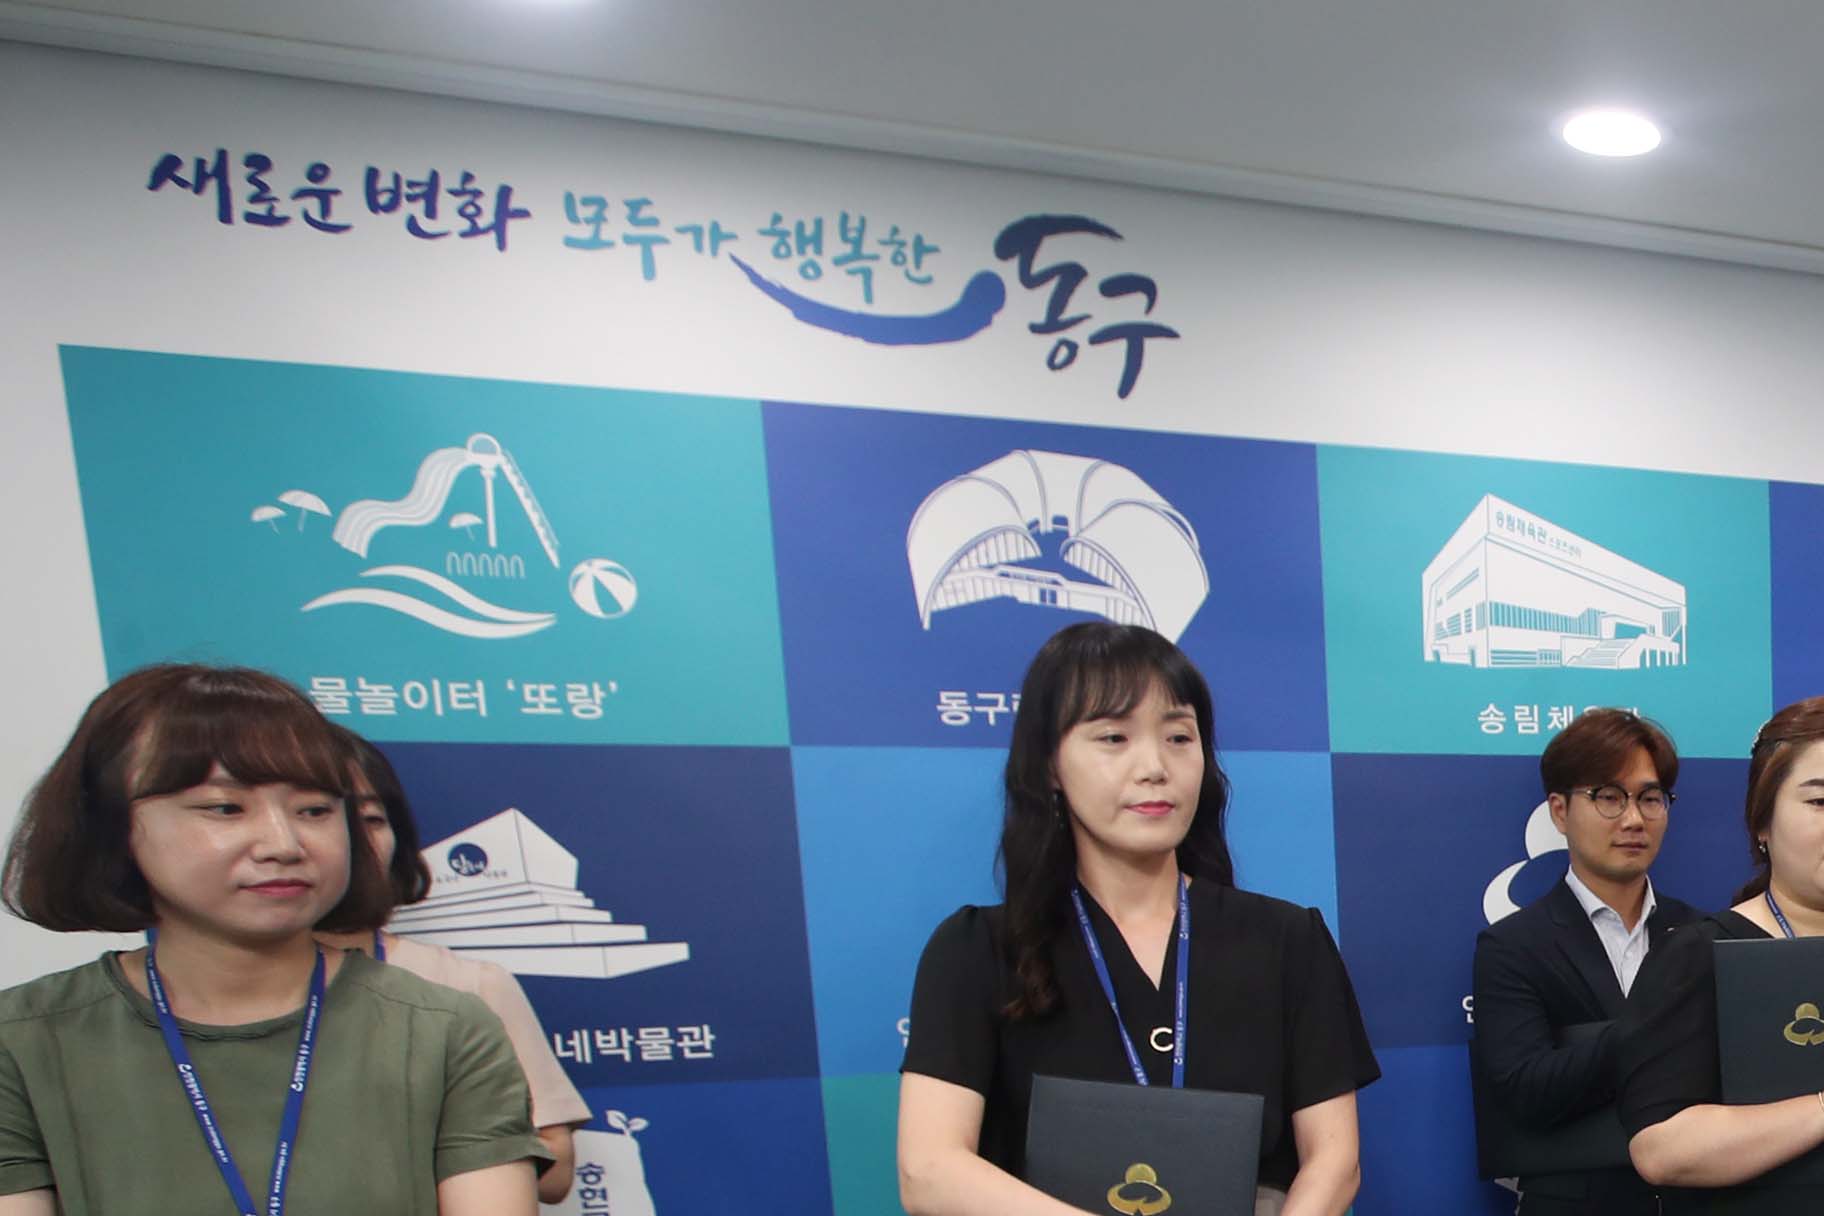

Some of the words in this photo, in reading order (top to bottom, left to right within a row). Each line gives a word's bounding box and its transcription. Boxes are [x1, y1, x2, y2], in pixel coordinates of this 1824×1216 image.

[147, 149, 353, 234] 새로운
[364, 164, 532, 252] 변화
[562, 191, 738, 282] 모두가
[757, 211, 941, 305] 행복한
[993, 213, 1181, 399] 동구
[309, 676, 487, 717] 물놀이터
[936, 690, 1021, 726] 동구
[553, 1024, 716, 1064] 네박물관
